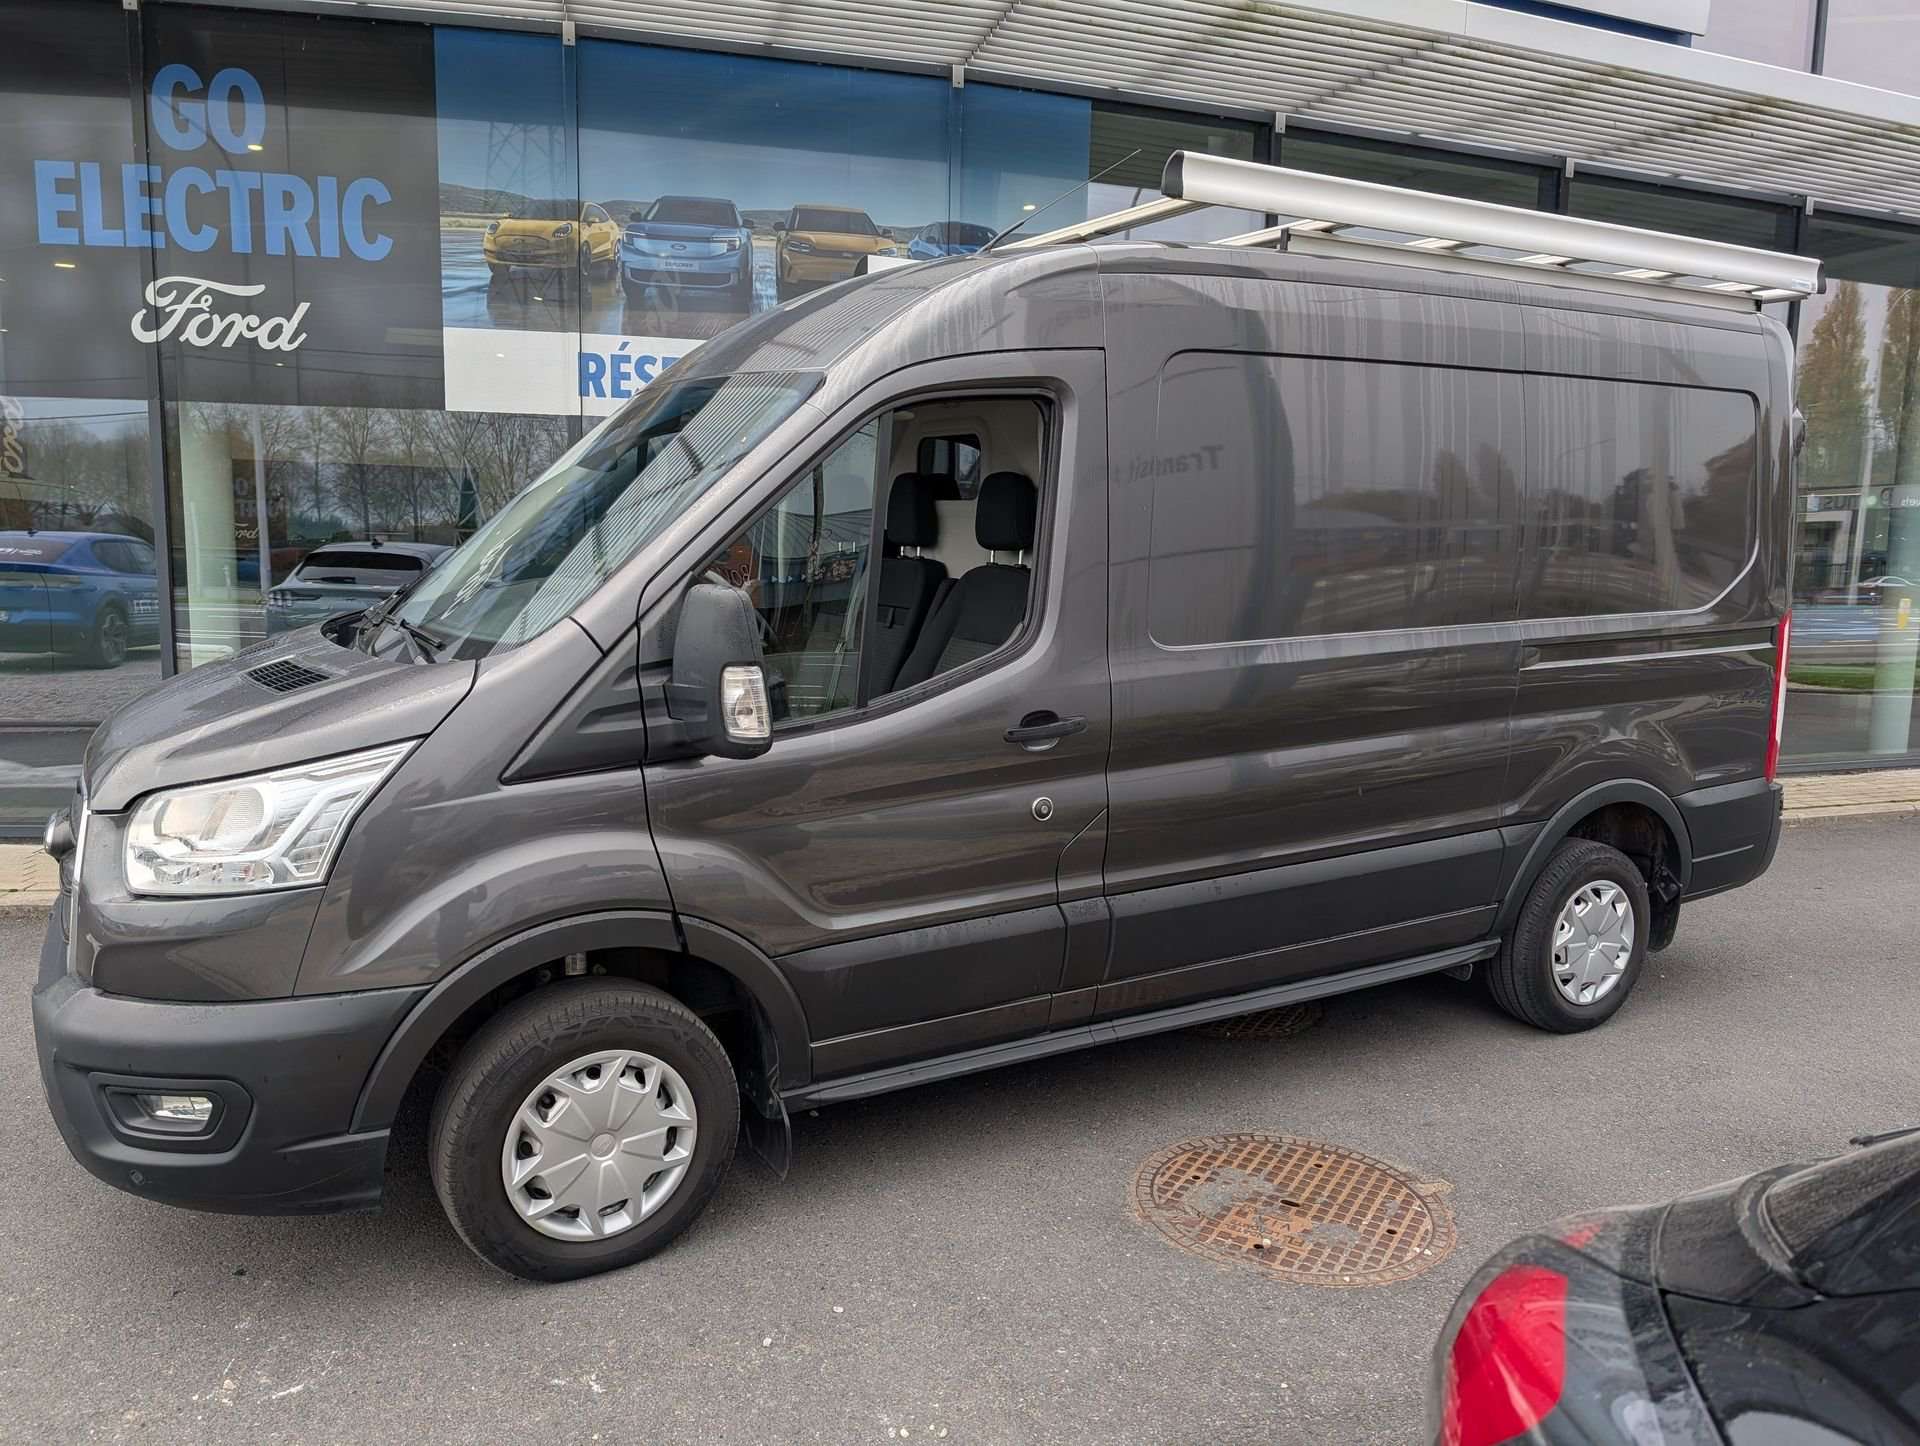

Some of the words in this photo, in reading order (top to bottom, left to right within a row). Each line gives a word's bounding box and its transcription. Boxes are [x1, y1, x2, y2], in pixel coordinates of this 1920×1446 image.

[152, 63, 267, 155] GO
[34, 160, 394, 262] ELECTRIC
[130, 275, 312, 352] Ford
[577, 341, 682, 399] RÉS
